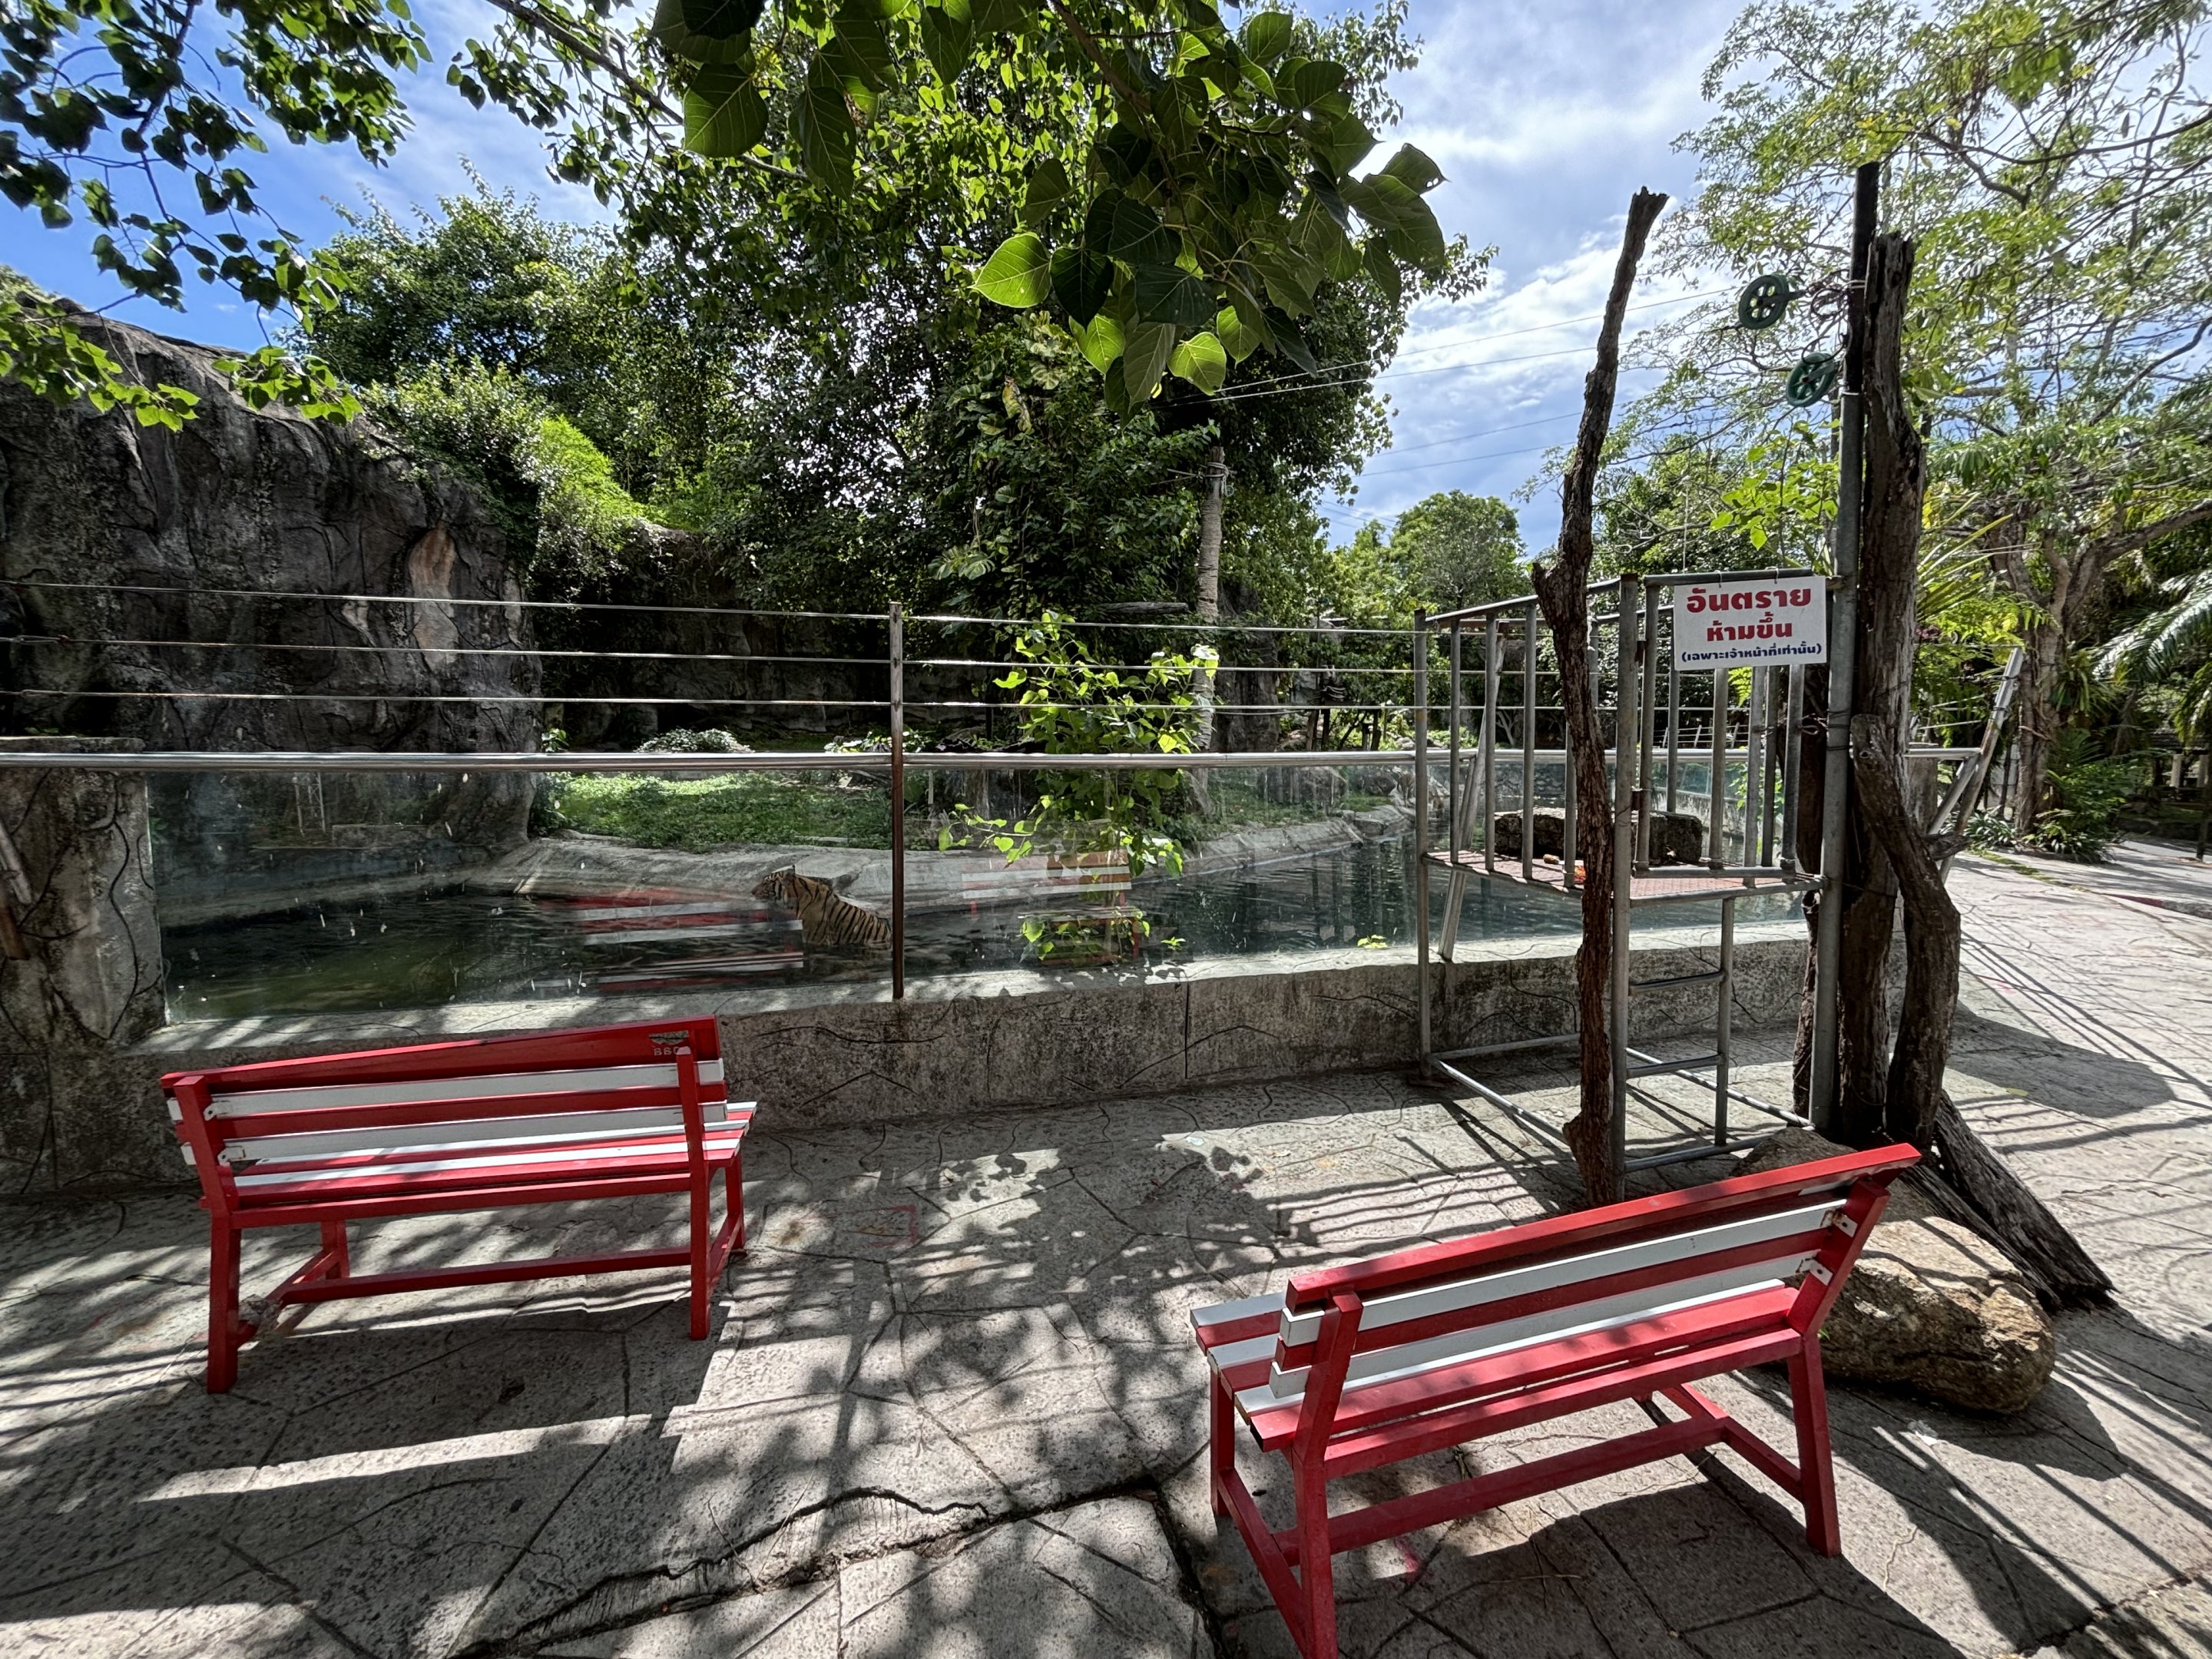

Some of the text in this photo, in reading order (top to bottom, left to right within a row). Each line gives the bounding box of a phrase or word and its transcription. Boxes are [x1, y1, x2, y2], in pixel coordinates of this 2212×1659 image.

[1687, 588, 1812, 613] อันตราย
[1707, 611, 1793, 642] ห้ามขึ้น
[1681, 641, 1823, 663] (เฉพาะเจ้าหน้าที่เท่านั้น)
